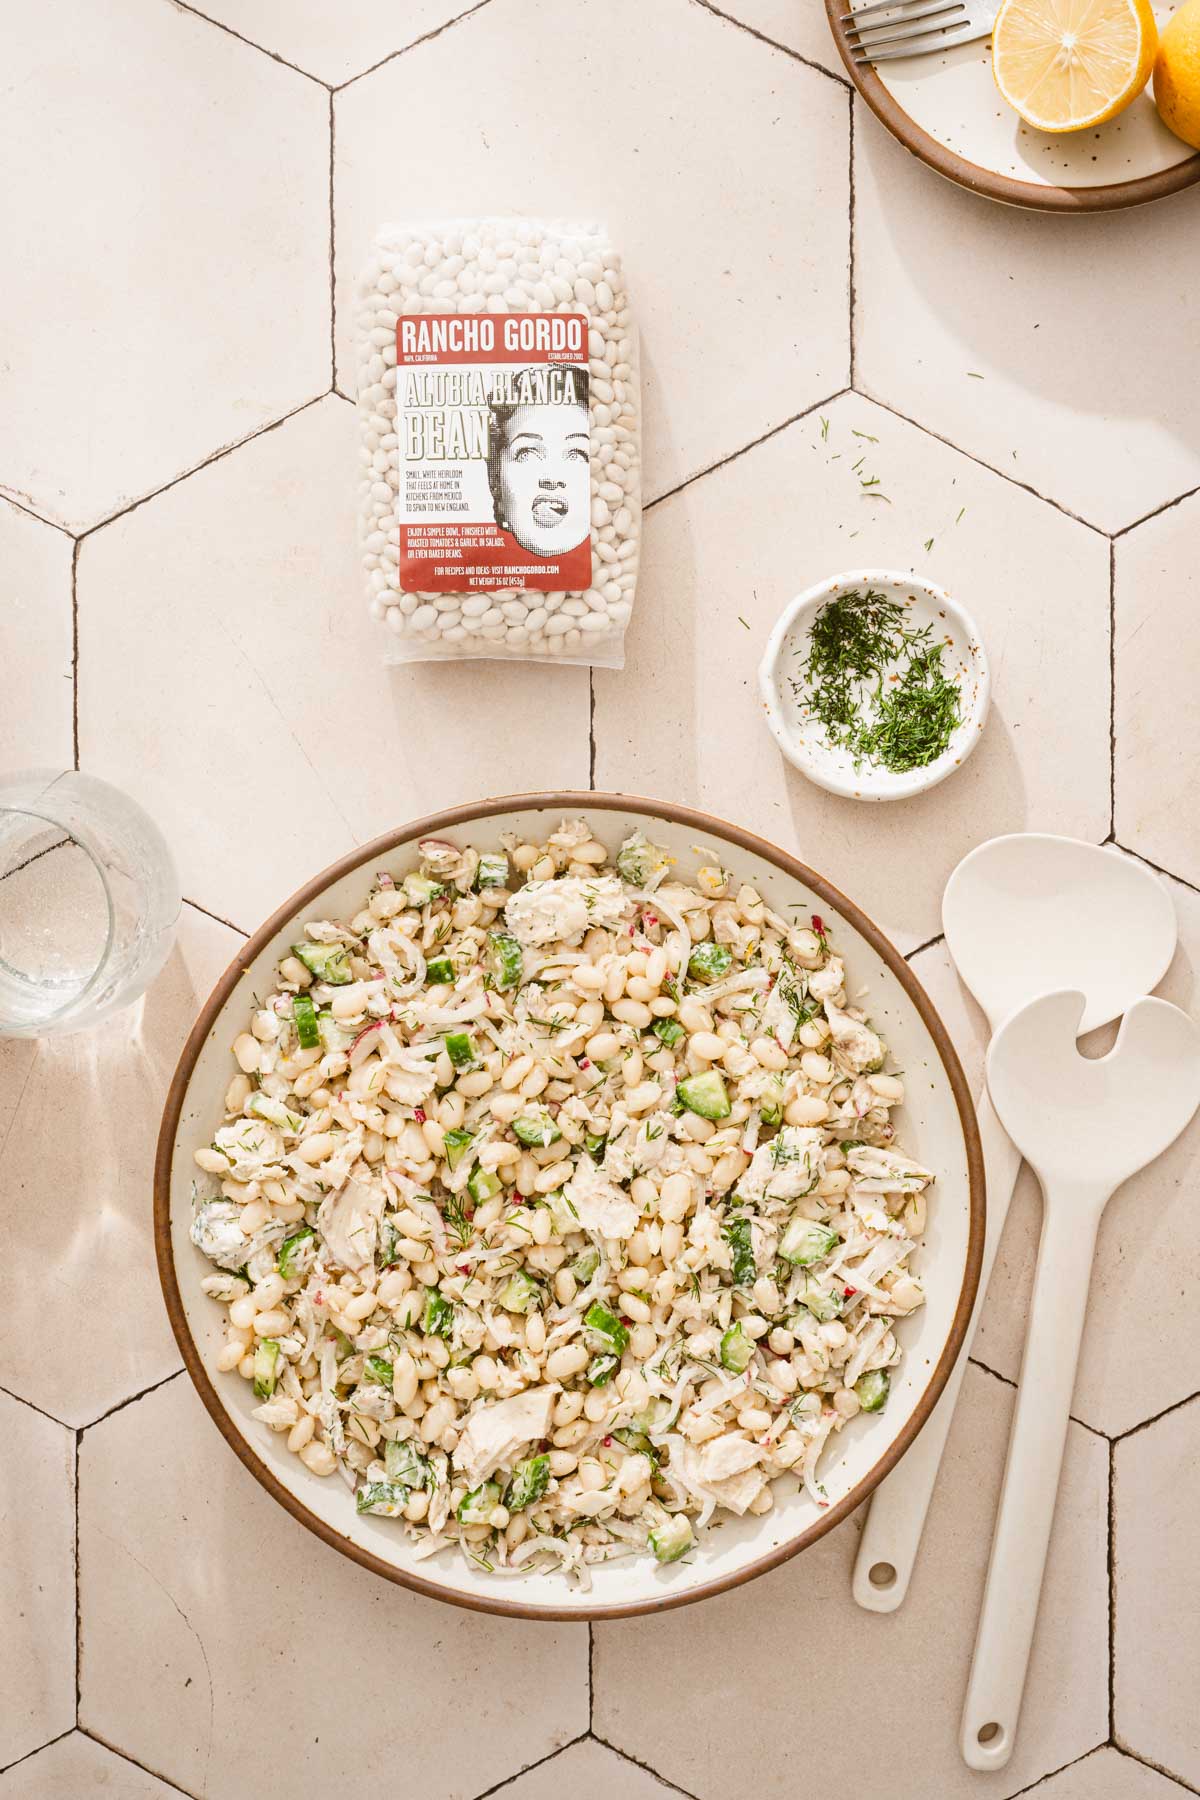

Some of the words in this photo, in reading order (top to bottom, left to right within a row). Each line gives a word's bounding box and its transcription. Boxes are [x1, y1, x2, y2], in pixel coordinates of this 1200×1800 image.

[402, 320, 495, 353] RANCHO
[404, 371, 487, 407] ALUBIA
[490, 370, 578, 405] BLANCA
[404, 410, 491, 460] BEAN
[422, 470, 436, 479] WHITE
[438, 470, 462, 479] HEIRLOOM
[406, 481, 416, 490] THAT
[418, 481, 432, 490] FEELS
[433, 481, 438, 490] AT
[440, 481, 453, 489] HOME
[454, 480, 460, 489] IN
[406, 492, 428, 501] KITCHENS
[430, 492, 443, 501] FROM
[444, 491, 462, 500] MEXICO
[406, 503, 412, 512] TO
[413, 503, 426, 512] SPAIN
[428, 503, 433, 512] TO
[435, 503, 445, 511] NEW
[407, 527, 422, 537] ENJOY
[423, 527, 427, 536] A
[427, 527, 445, 536] SIMPLE
[462, 527, 484, 536] FINISHED
[485, 527, 498, 536] WITH
[407, 538, 428, 548] ROASTED
[430, 538, 454, 547] TOMATOES
[455, 537, 459, 547] &
[479, 537, 485, 547] IN
[407, 549, 414, 558] OR
[416, 549, 428, 558] EVEN
[429, 549, 444, 558] BAKED
[446, 548, 463, 558] BEANS.
[434, 566, 443, 576] FOR
[445, 566, 464, 575] RECIPES
[465, 566, 474, 575] AND
[492, 566, 503, 575] VISIT
[504, 565, 560, 575] RANCHOGORDO.COM
[469, 577, 478, 586] NET
[479, 577, 495, 586] WEIGHT
[496, 577, 502, 585] 16
